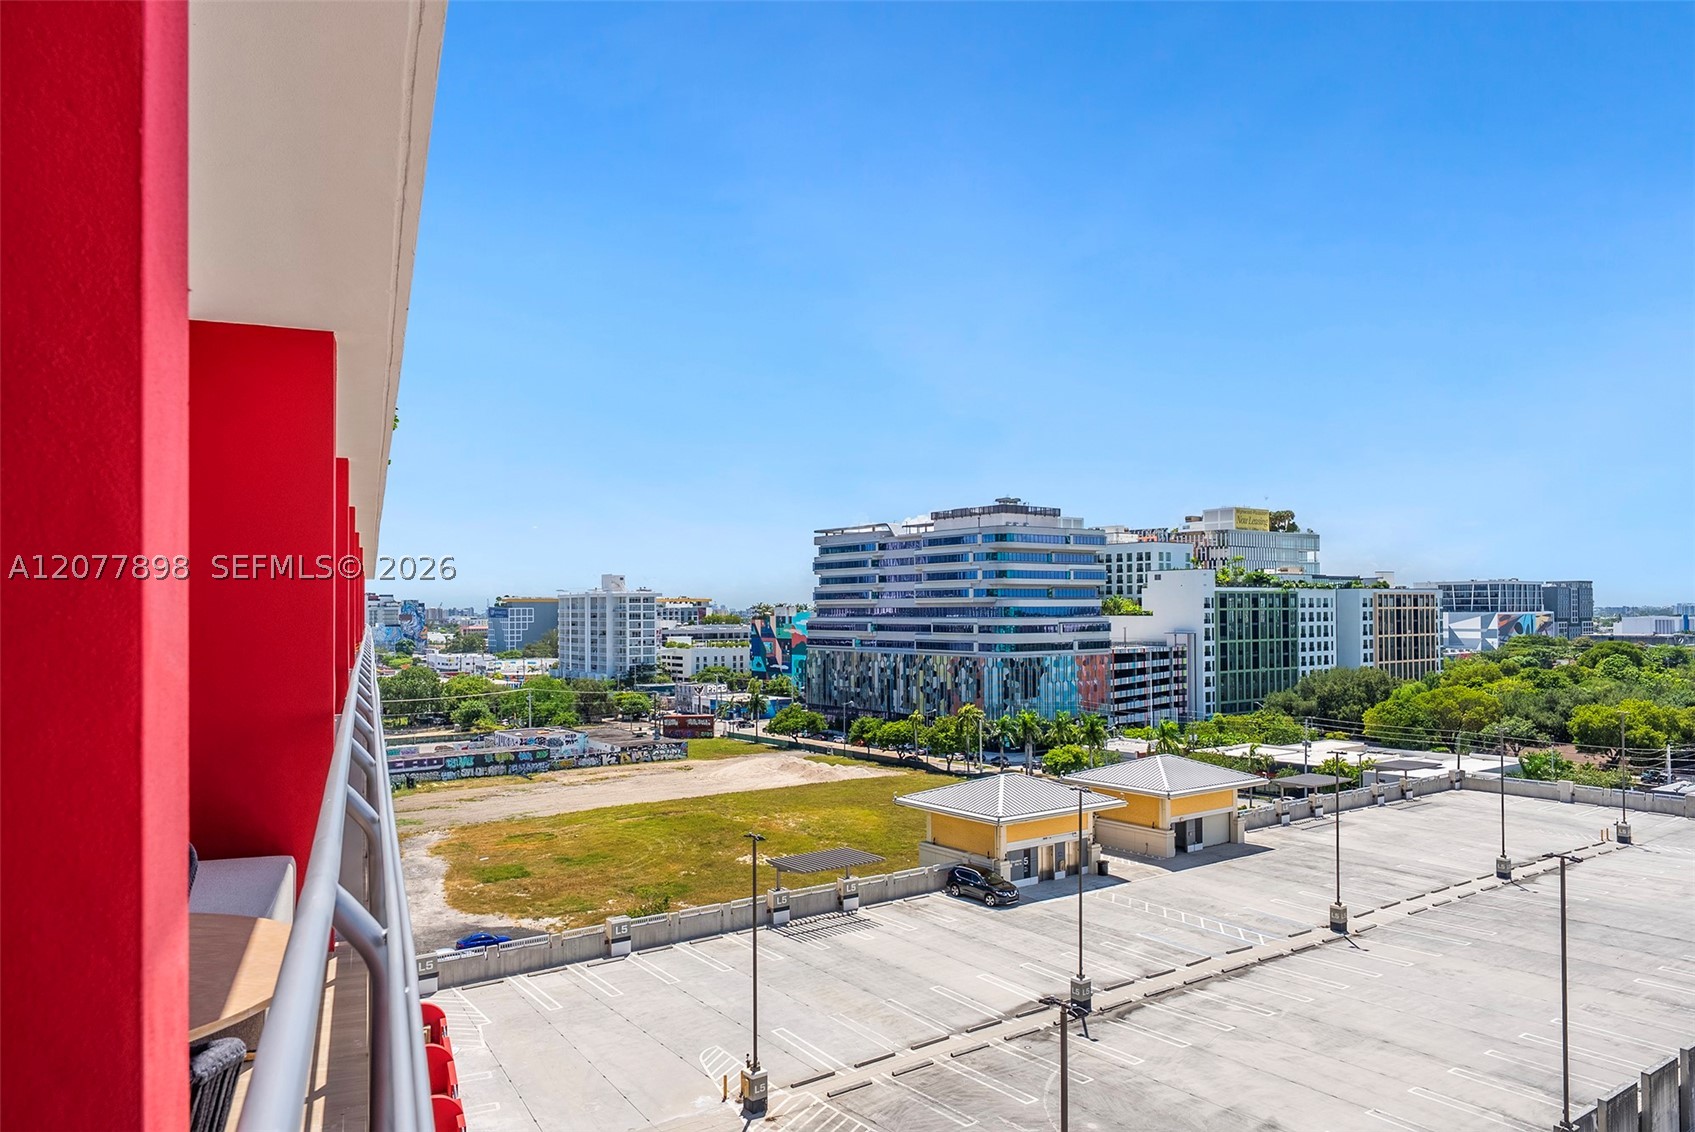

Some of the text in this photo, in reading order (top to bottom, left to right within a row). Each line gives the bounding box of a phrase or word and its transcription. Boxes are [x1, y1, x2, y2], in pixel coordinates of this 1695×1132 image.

[1248, 516, 1268, 527] Leasing
[1023, 856, 1029, 865] 5
[846, 883, 857, 893] L5
[776, 895, 788, 905] L5
[1331, 911, 1340, 919] L5
[615, 925, 628, 935] L5
[418, 960, 433, 972] L5
[1072, 987, 1080, 996] L5
[1082, 987, 1090, 996] L5
[754, 1083, 766, 1094] L5
